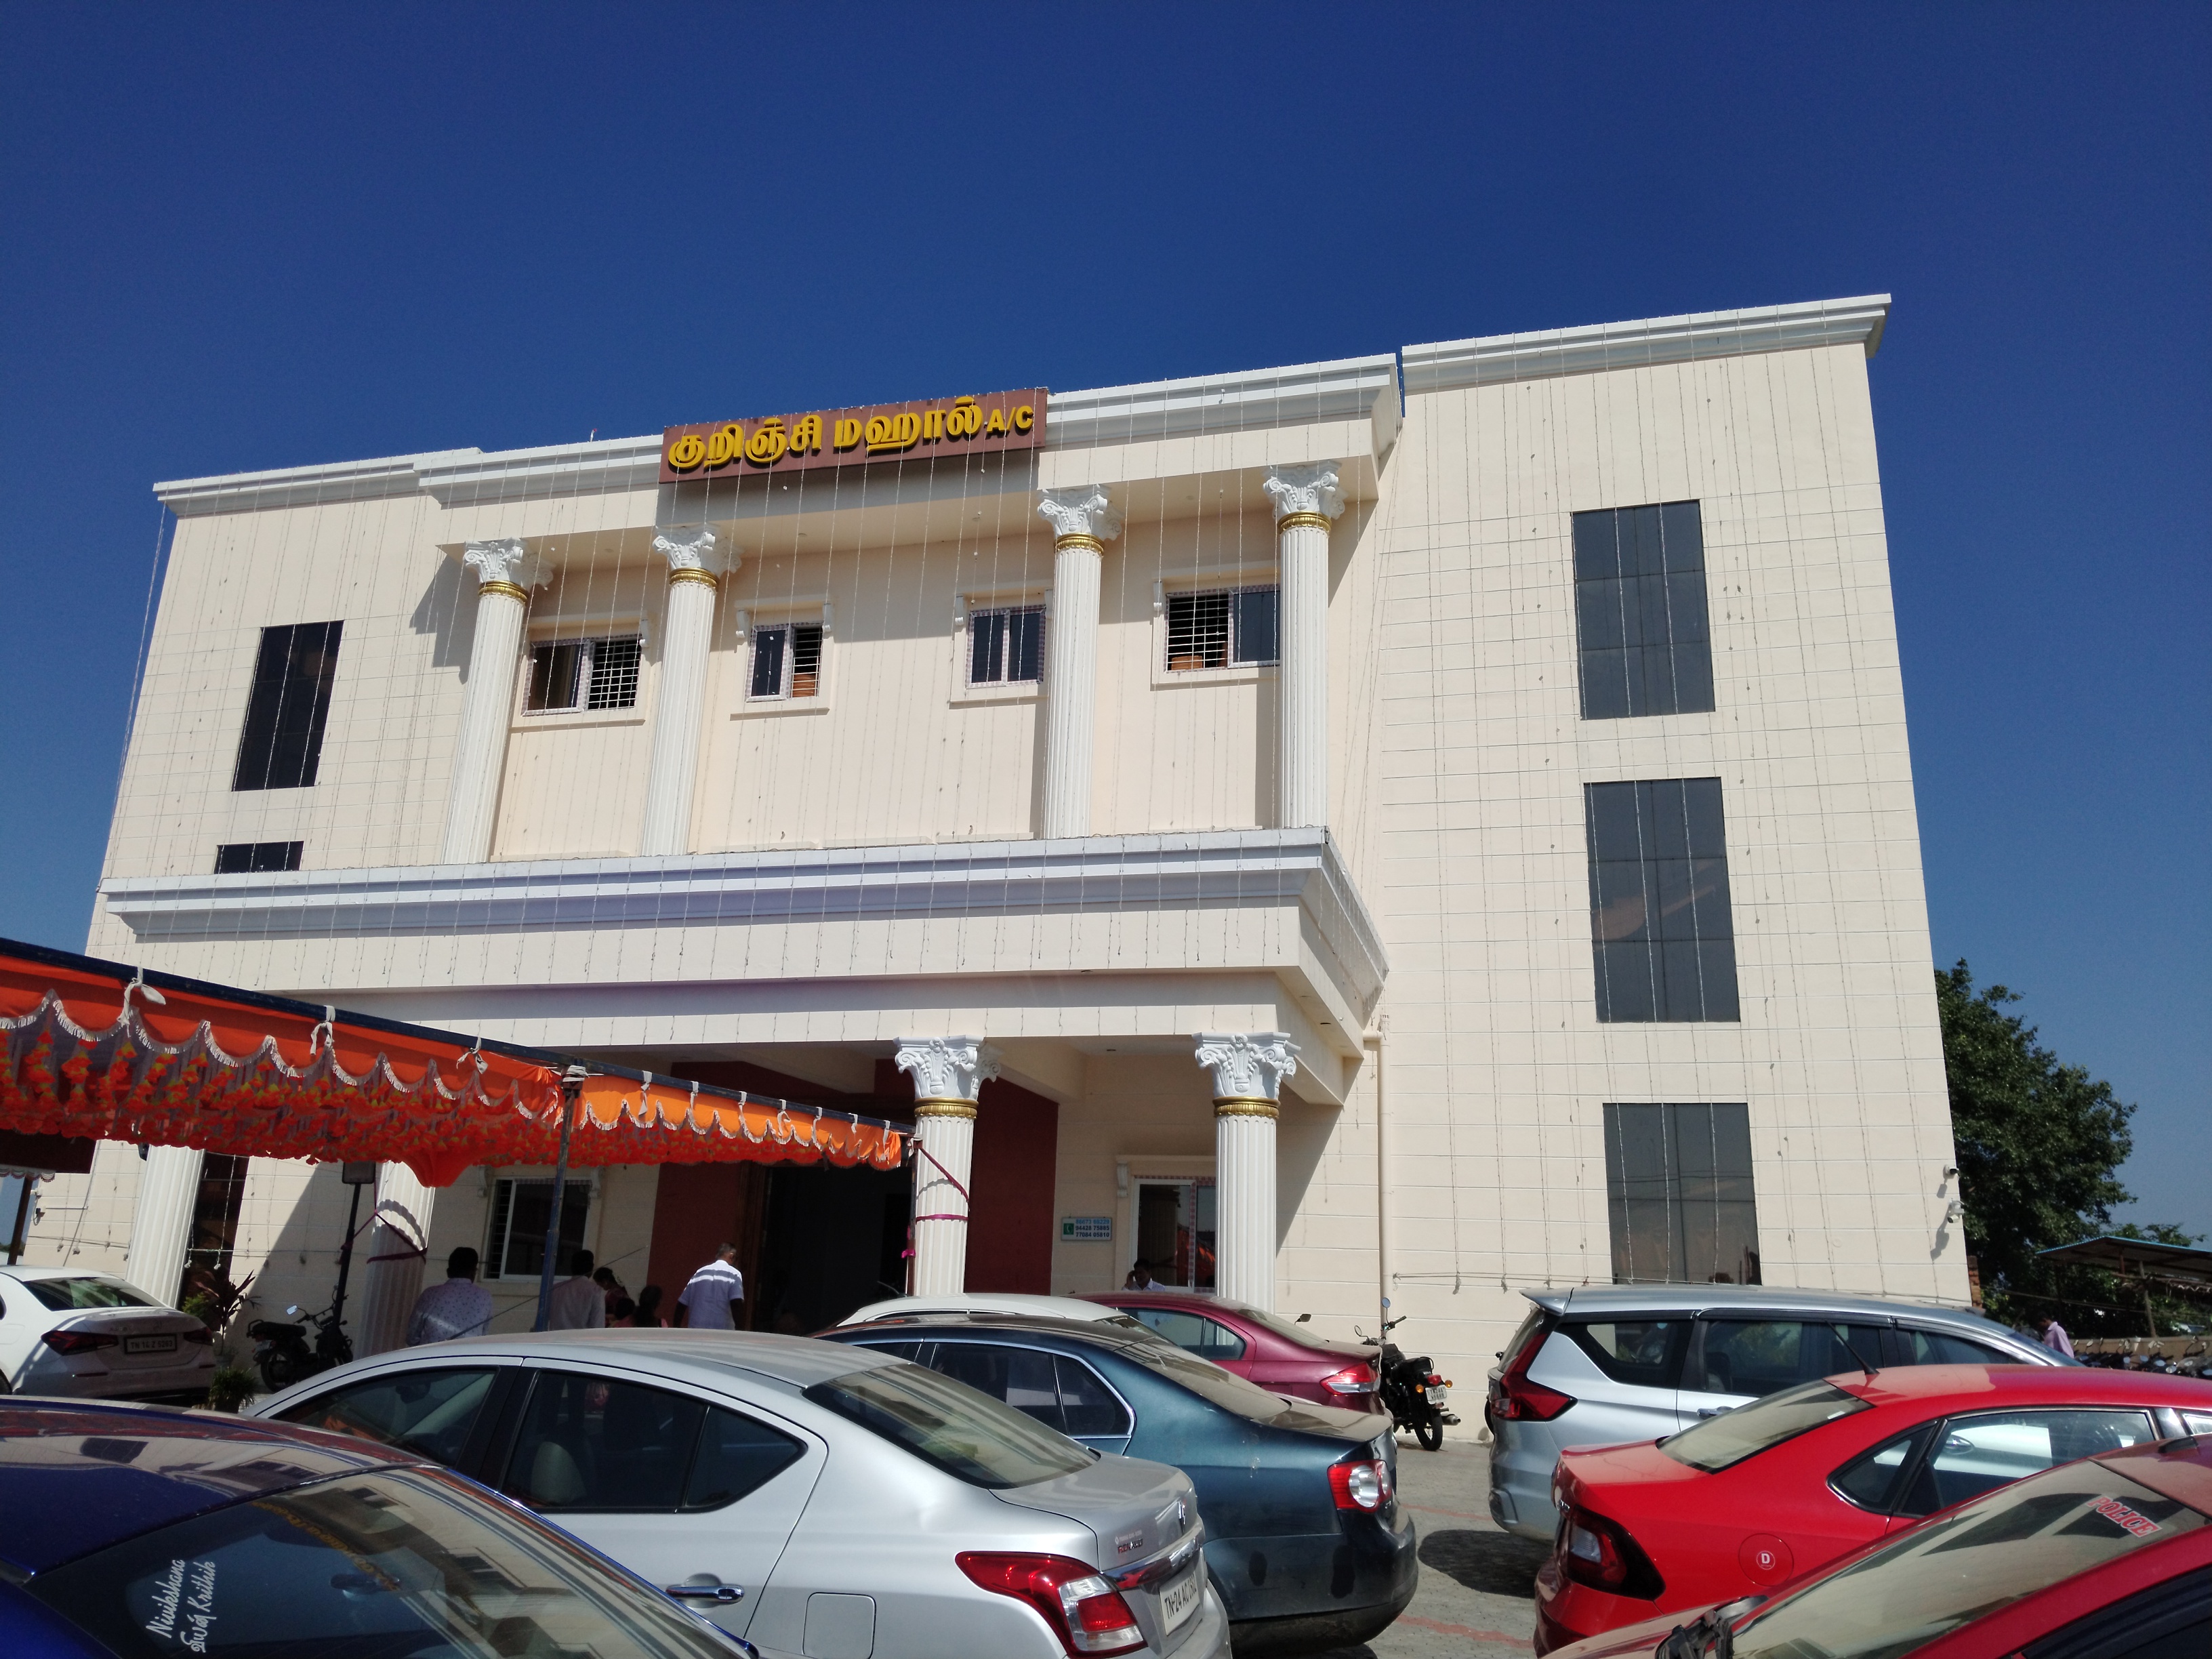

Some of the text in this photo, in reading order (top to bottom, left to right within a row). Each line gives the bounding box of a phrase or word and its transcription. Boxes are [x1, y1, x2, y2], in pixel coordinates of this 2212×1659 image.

[668, 396, 1033, 469] குறிஞ்சி மஹால் A/C
[2087, 1496, 2163, 1537] POLICE
[1761, 1553, 1770, 1564] D
[146, 1559, 185, 1638] Nivikshana
[187, 1561, 216, 1612] Krithik
